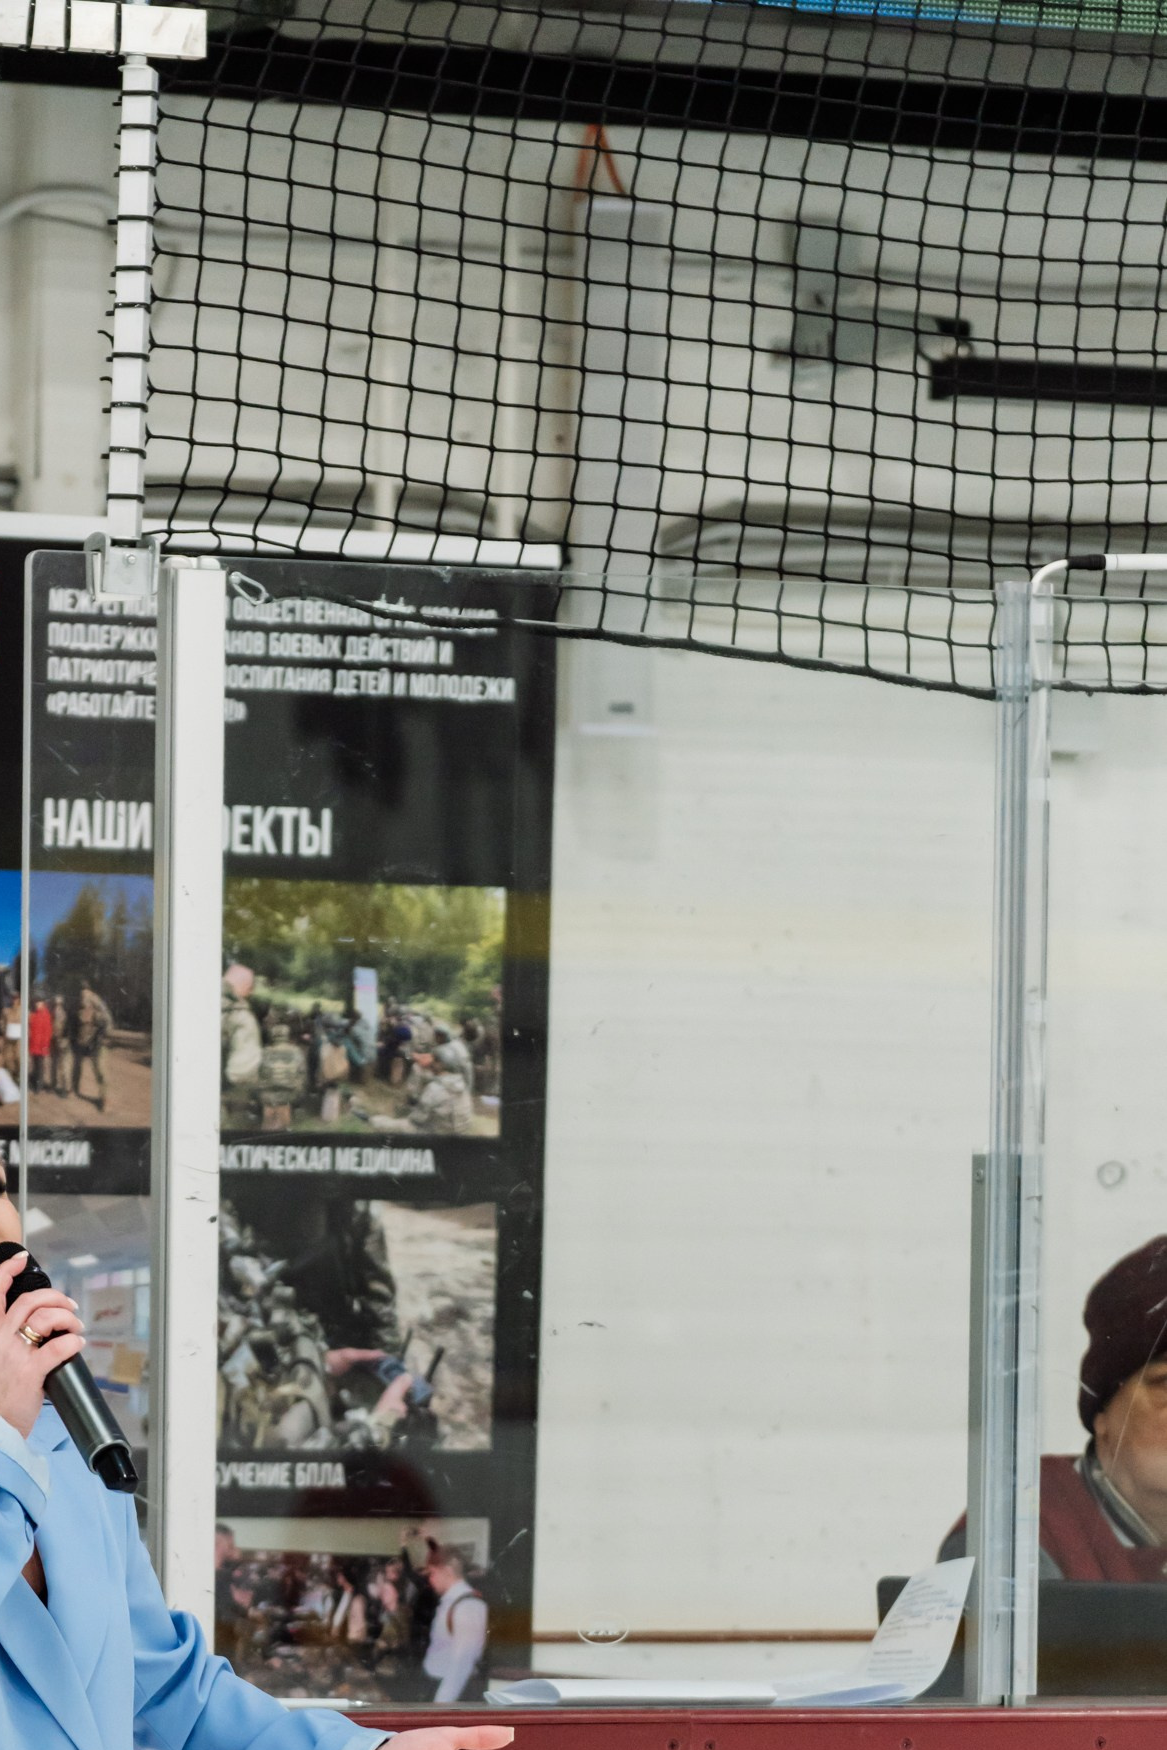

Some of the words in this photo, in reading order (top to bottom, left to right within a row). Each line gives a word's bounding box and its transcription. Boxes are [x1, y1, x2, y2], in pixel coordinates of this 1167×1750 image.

[268, 631, 342, 659] БОЕВЫХ
[343, 633, 438, 666] ДЕЙСТВИЙ
[439, 640, 454, 666] И
[47, 656, 157, 686] ПАТРИОТИЧЕ
[225, 664, 332, 692] ОСПИТАНИЯ
[333, 667, 391, 696] ДЕТЕЙ
[393, 672, 408, 697] И
[409, 673, 516, 702] МОЛОДЕЖИ
[42, 797, 153, 849] НАШИ
[219, 1144, 332, 1171] АКТИЧЕСКАЯ
[334, 1146, 435, 1176] МЕДИЦИНА
[294, 1461, 347, 1488] БПЛА
